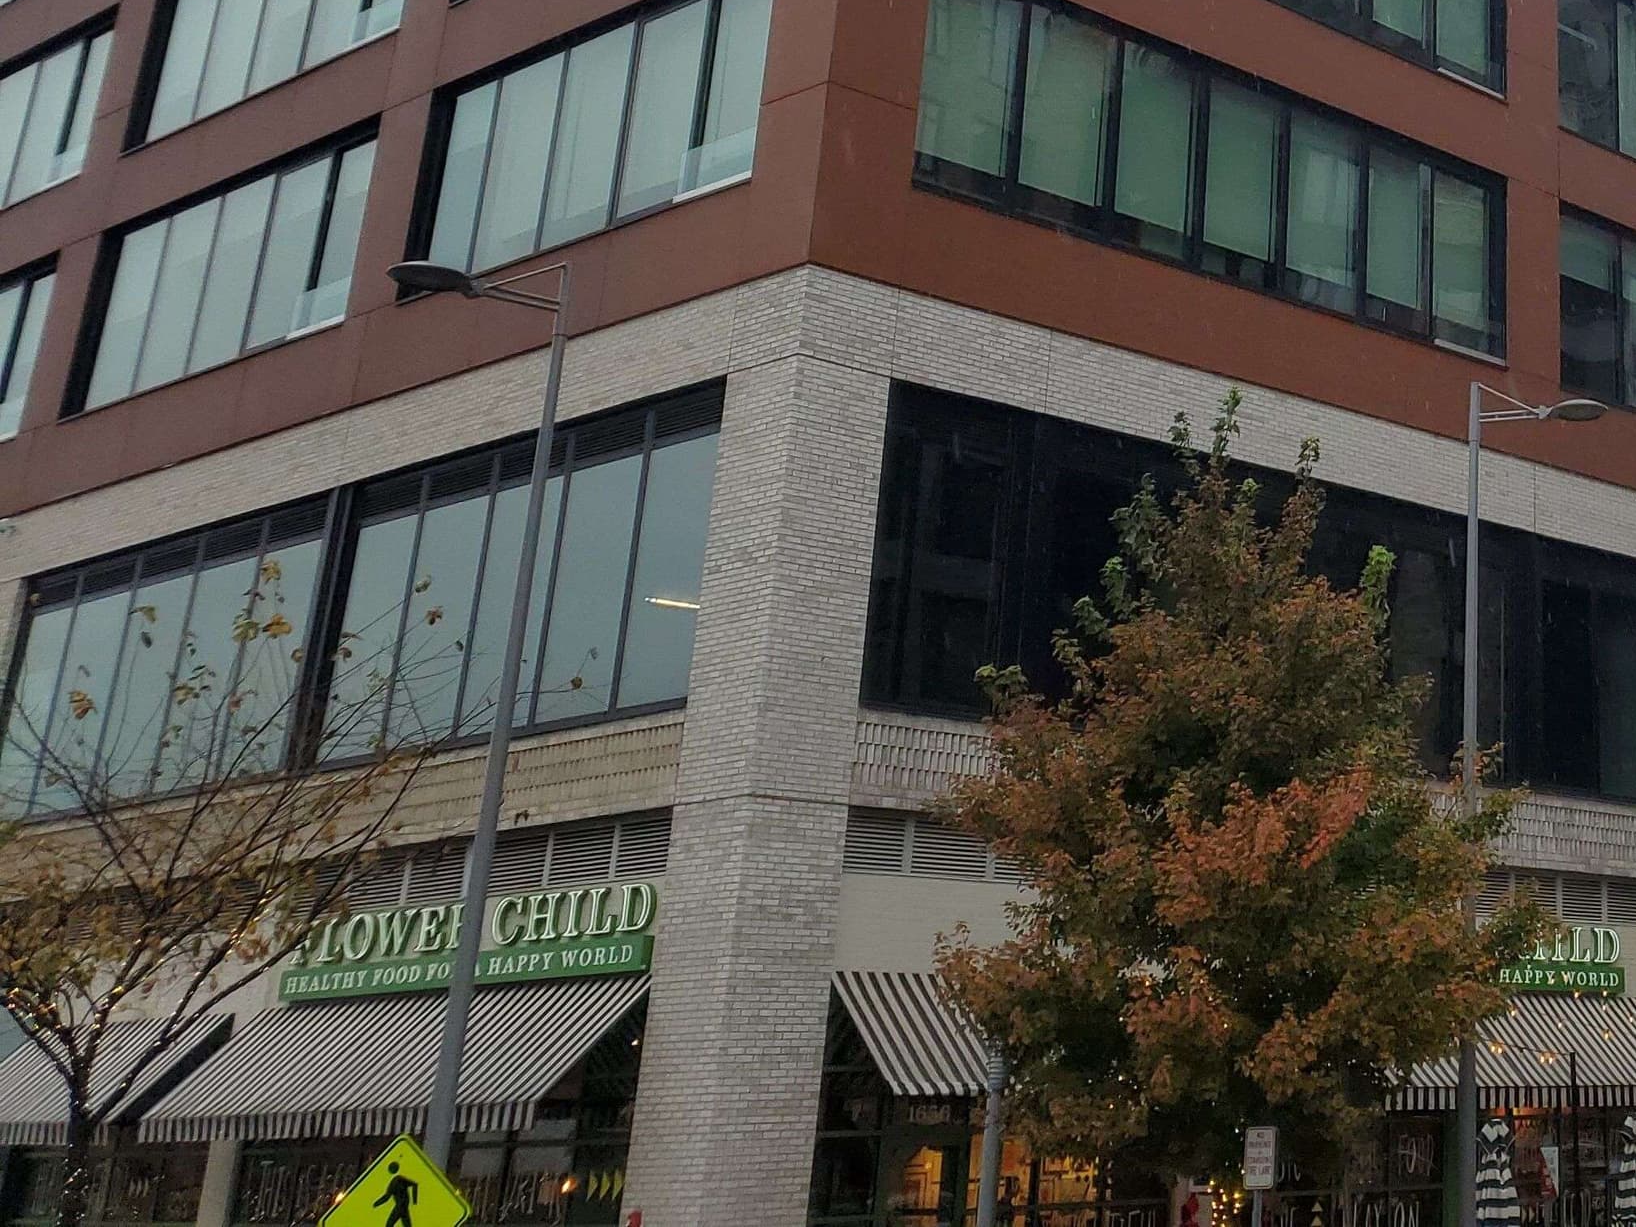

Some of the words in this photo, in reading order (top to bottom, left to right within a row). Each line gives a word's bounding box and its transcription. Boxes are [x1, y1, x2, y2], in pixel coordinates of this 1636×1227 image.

[492, 883, 656, 946] CHILD
[284, 970, 369, 995] HEALTHY
[371, 966, 421, 987] FOOD
[425, 961, 456, 981] FO
[486, 951, 556, 976] HAPPY
[560, 944, 634, 969] WORLD
[1499, 968, 1556, 985] HAPPY
[1561, 970, 1619, 987] WORLD
